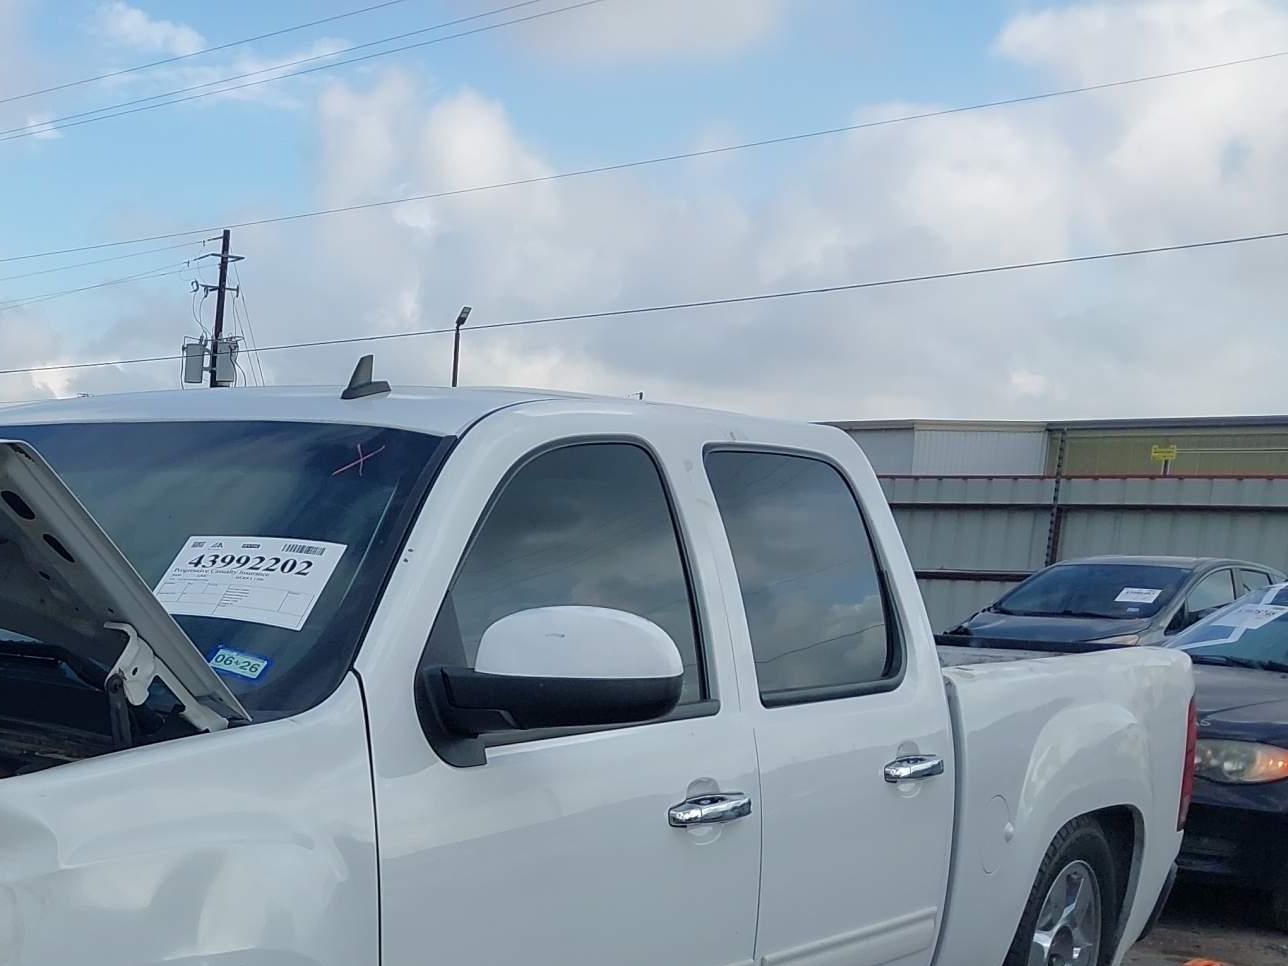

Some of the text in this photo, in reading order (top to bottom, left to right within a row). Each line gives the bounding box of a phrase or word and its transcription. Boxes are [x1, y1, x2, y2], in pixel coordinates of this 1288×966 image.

[188, 553, 313, 577] 43992202
[214, 653, 261, 673] 06 26
